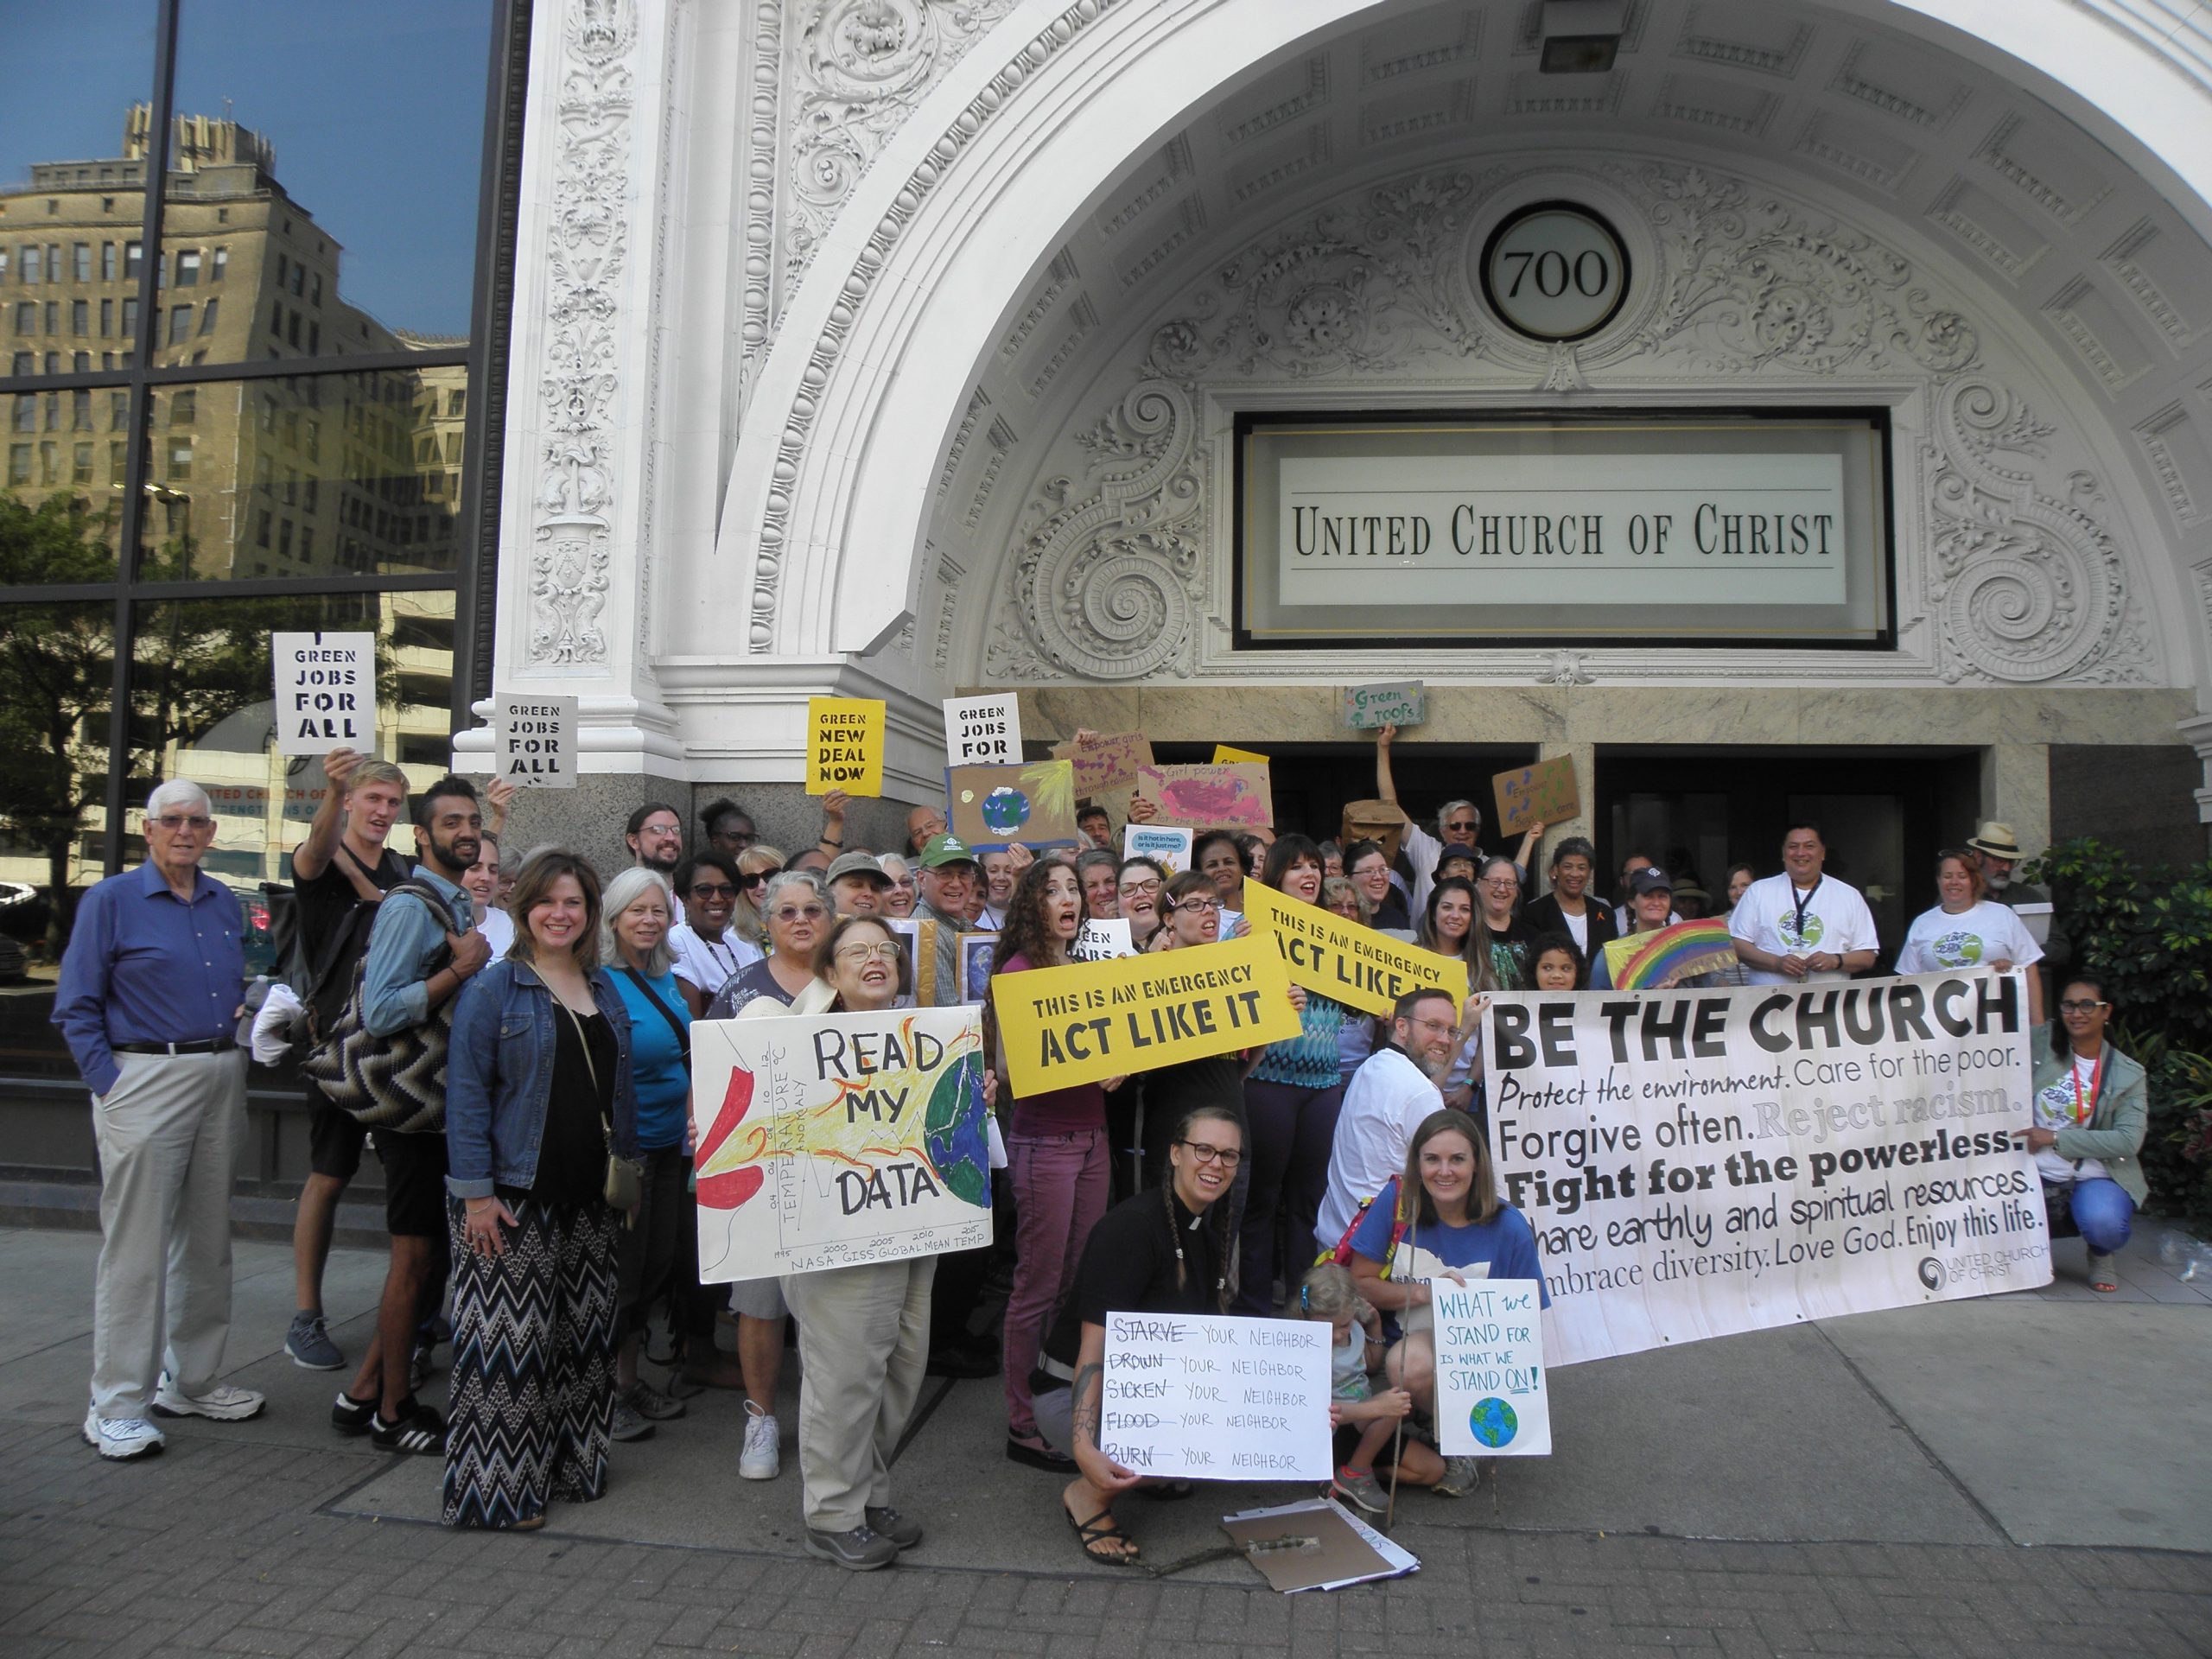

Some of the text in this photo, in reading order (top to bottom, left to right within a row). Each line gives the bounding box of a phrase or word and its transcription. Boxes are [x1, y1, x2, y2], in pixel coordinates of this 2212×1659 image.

[1503, 251, 1608, 297] 700
[1292, 506, 1431, 556] UNITED
[1452, 504, 1604, 556] CHURCH
[1694, 503, 1833, 555] CHRIST
[295, 650, 356, 663] GREEN
[295, 670, 356, 685] JOBS
[296, 693, 356, 712] FOR
[509, 705, 560, 716] GREEN
[1355, 690, 1402, 709] Green
[1374, 702, 1414, 722] roofs
[820, 715, 866, 724] GREEN
[959, 707, 1005, 721] GREEN
[298, 718, 357, 738] ALL
[509, 721, 560, 734] JOBS
[819, 729, 865, 742] NEW
[961, 722, 1006, 738] JOBS
[1122, 733, 1144, 748] girls
[509, 739, 559, 753] FOR
[819, 748, 865, 764] DEAL
[962, 740, 1007, 758] FOR
[509, 758, 560, 774] ALL
[820, 767, 865, 781] NOW
[1167, 766, 1230, 777] Girl power
[247, 789, 304, 800] CHCH
[1084, 932, 1111, 944] EEN
[1271, 907, 1440, 982] THIS IS AN EMERGENCY
[1077, 948, 1112, 961] OBS
[1337, 954, 1402, 1001] LIKE
[1033, 964, 1252, 1019] THIS IS AN EMERGENCY
[1041, 990, 1261, 1067] ACT LIKE IT
[1492, 976, 2019, 1070] BE THE CHURCH
[813, 1028, 943, 1080] READ
[1795, 1046, 2020, 1086] Care for the poor.
[1497, 1065, 1789, 1112] Protect the environment.
[792, 1079, 807, 1151] ANOMALY
[846, 1087, 909, 1123] MY
[1752, 1095, 1886, 1143] Reject
[1893, 1080, 2023, 1125] racism.
[775, 1071, 797, 1224] TEMPERATURE
[1498, 1103, 1754, 1168] Forgive often.
[1504, 1128, 2024, 1214] Fight for the powerless.
[836, 1162, 940, 1216] DATA
[1529, 1170, 2035, 1255] hare earthly and spiritual resources.
[823, 1243, 849, 1253] 2000
[869, 1236, 895, 1248] 2005
[912, 1230, 934, 1241] 2010
[962, 1224, 979, 1235] 2015
[1776, 1199, 2044, 1266] Love God. Enjoy this life.
[791, 1233, 984, 1271] NASA GISS GLOBAL MEAN TEMP
[1945, 1244, 2049, 1270] UNITED CHURCH
[1545, 1242, 1770, 1298] mbrace diversity.
[1949, 1263, 2012, 1283] OF CHRIST
[1439, 1291, 1497, 1319] WHAT
[1112, 1318, 1320, 1348] STARVE YOUR NEIGHBOR
[1446, 1324, 1530, 1345] STAND FOR
[1109, 1352, 1306, 1381] DROWN YOUR NEIGHBOR
[1440, 1351, 1513, 1365] IS WHAT WE
[1449, 1367, 1538, 1391] STAND ON!
[1106, 1379, 1308, 1407] SICKEN YOUR NEIGHBOR
[1106, 1412, 1292, 1431] FLOOD YOUR NEIGHBOR
[1104, 1443, 1301, 1472] BURN YOUR NEIGHBOR
